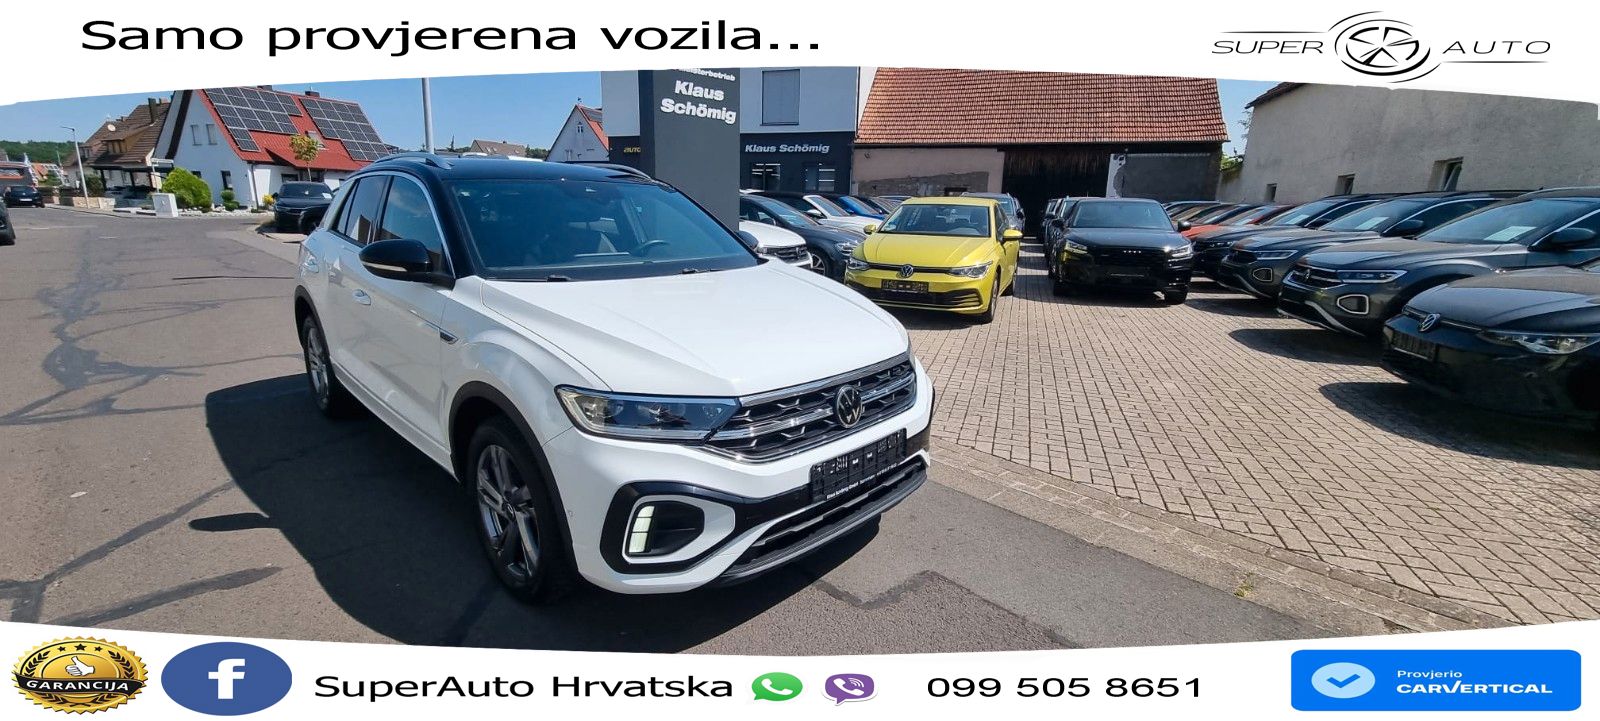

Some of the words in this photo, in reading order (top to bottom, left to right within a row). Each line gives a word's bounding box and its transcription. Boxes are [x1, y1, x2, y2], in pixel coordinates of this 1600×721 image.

[678, 68, 736, 81] isterbetrieb
[674, 80, 725, 101] Klaus
[660, 98, 737, 125] Schömig
[745, 144, 776, 153] Klaus
[778, 143, 830, 154] Schömig
